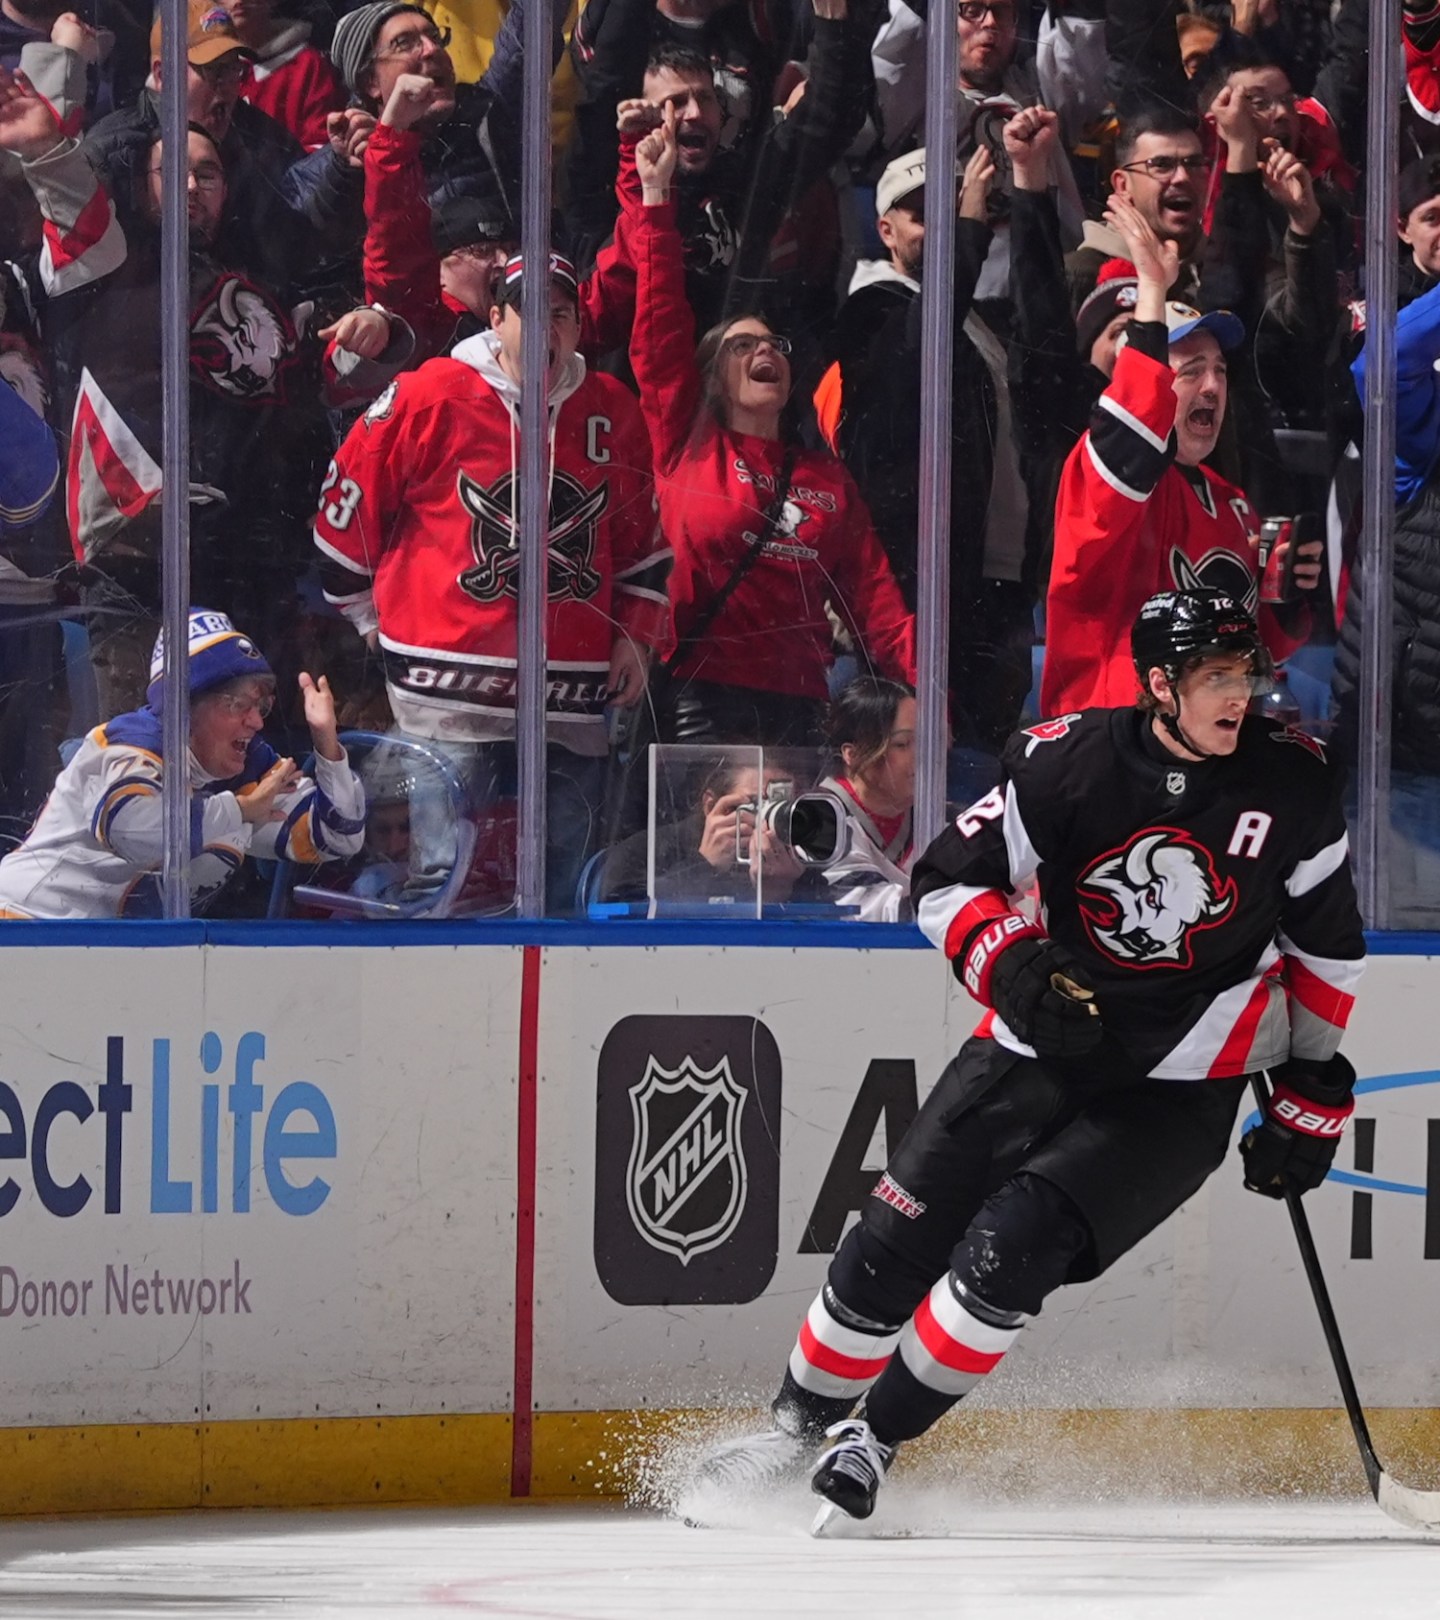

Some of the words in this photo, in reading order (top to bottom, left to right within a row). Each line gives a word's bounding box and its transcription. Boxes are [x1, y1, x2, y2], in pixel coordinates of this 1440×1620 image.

[586, 415, 611, 463] C
[317, 458, 363, 531] 23
[401, 664, 608, 702] BUFAL
[1227, 810, 1273, 859] A
[1274, 1098, 1353, 1135] BAU
[653, 1109, 722, 1216] NHL
[0, 1264, 93, 1318] Donor
[105, 1258, 252, 1316] Network
